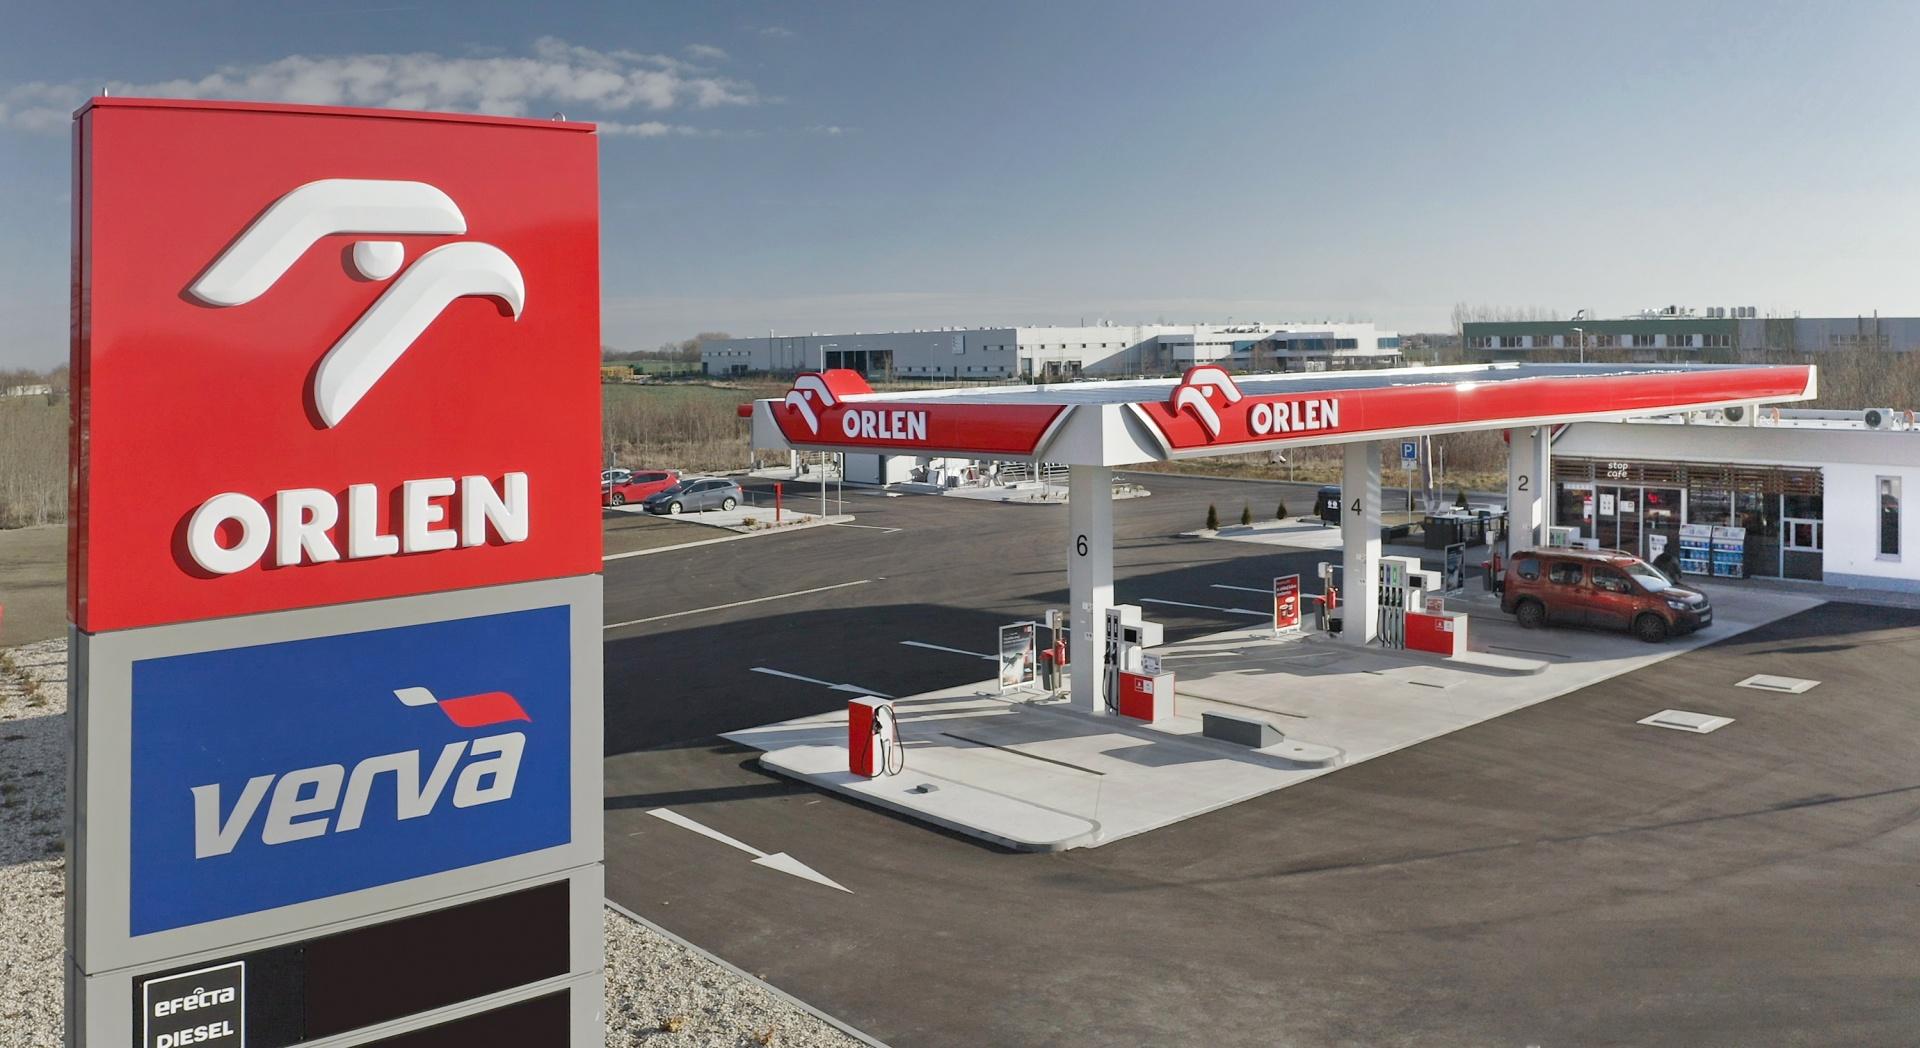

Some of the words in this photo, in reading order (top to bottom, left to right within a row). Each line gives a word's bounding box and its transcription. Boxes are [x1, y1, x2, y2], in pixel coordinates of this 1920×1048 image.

[842, 408, 927, 441] ORLEN
[1251, 399, 1339, 434] ORLEN
[1404, 444, 1413, 457] P
[1608, 463, 1628, 471] stop
[1518, 475, 1528, 491] 2
[1351, 498, 1362, 516] 4
[186, 471, 529, 575] ORLEN
[1076, 534, 1088, 556] 6
[191, 732, 526, 859] verva
[156, 1020, 234, 1048] DIESEL
